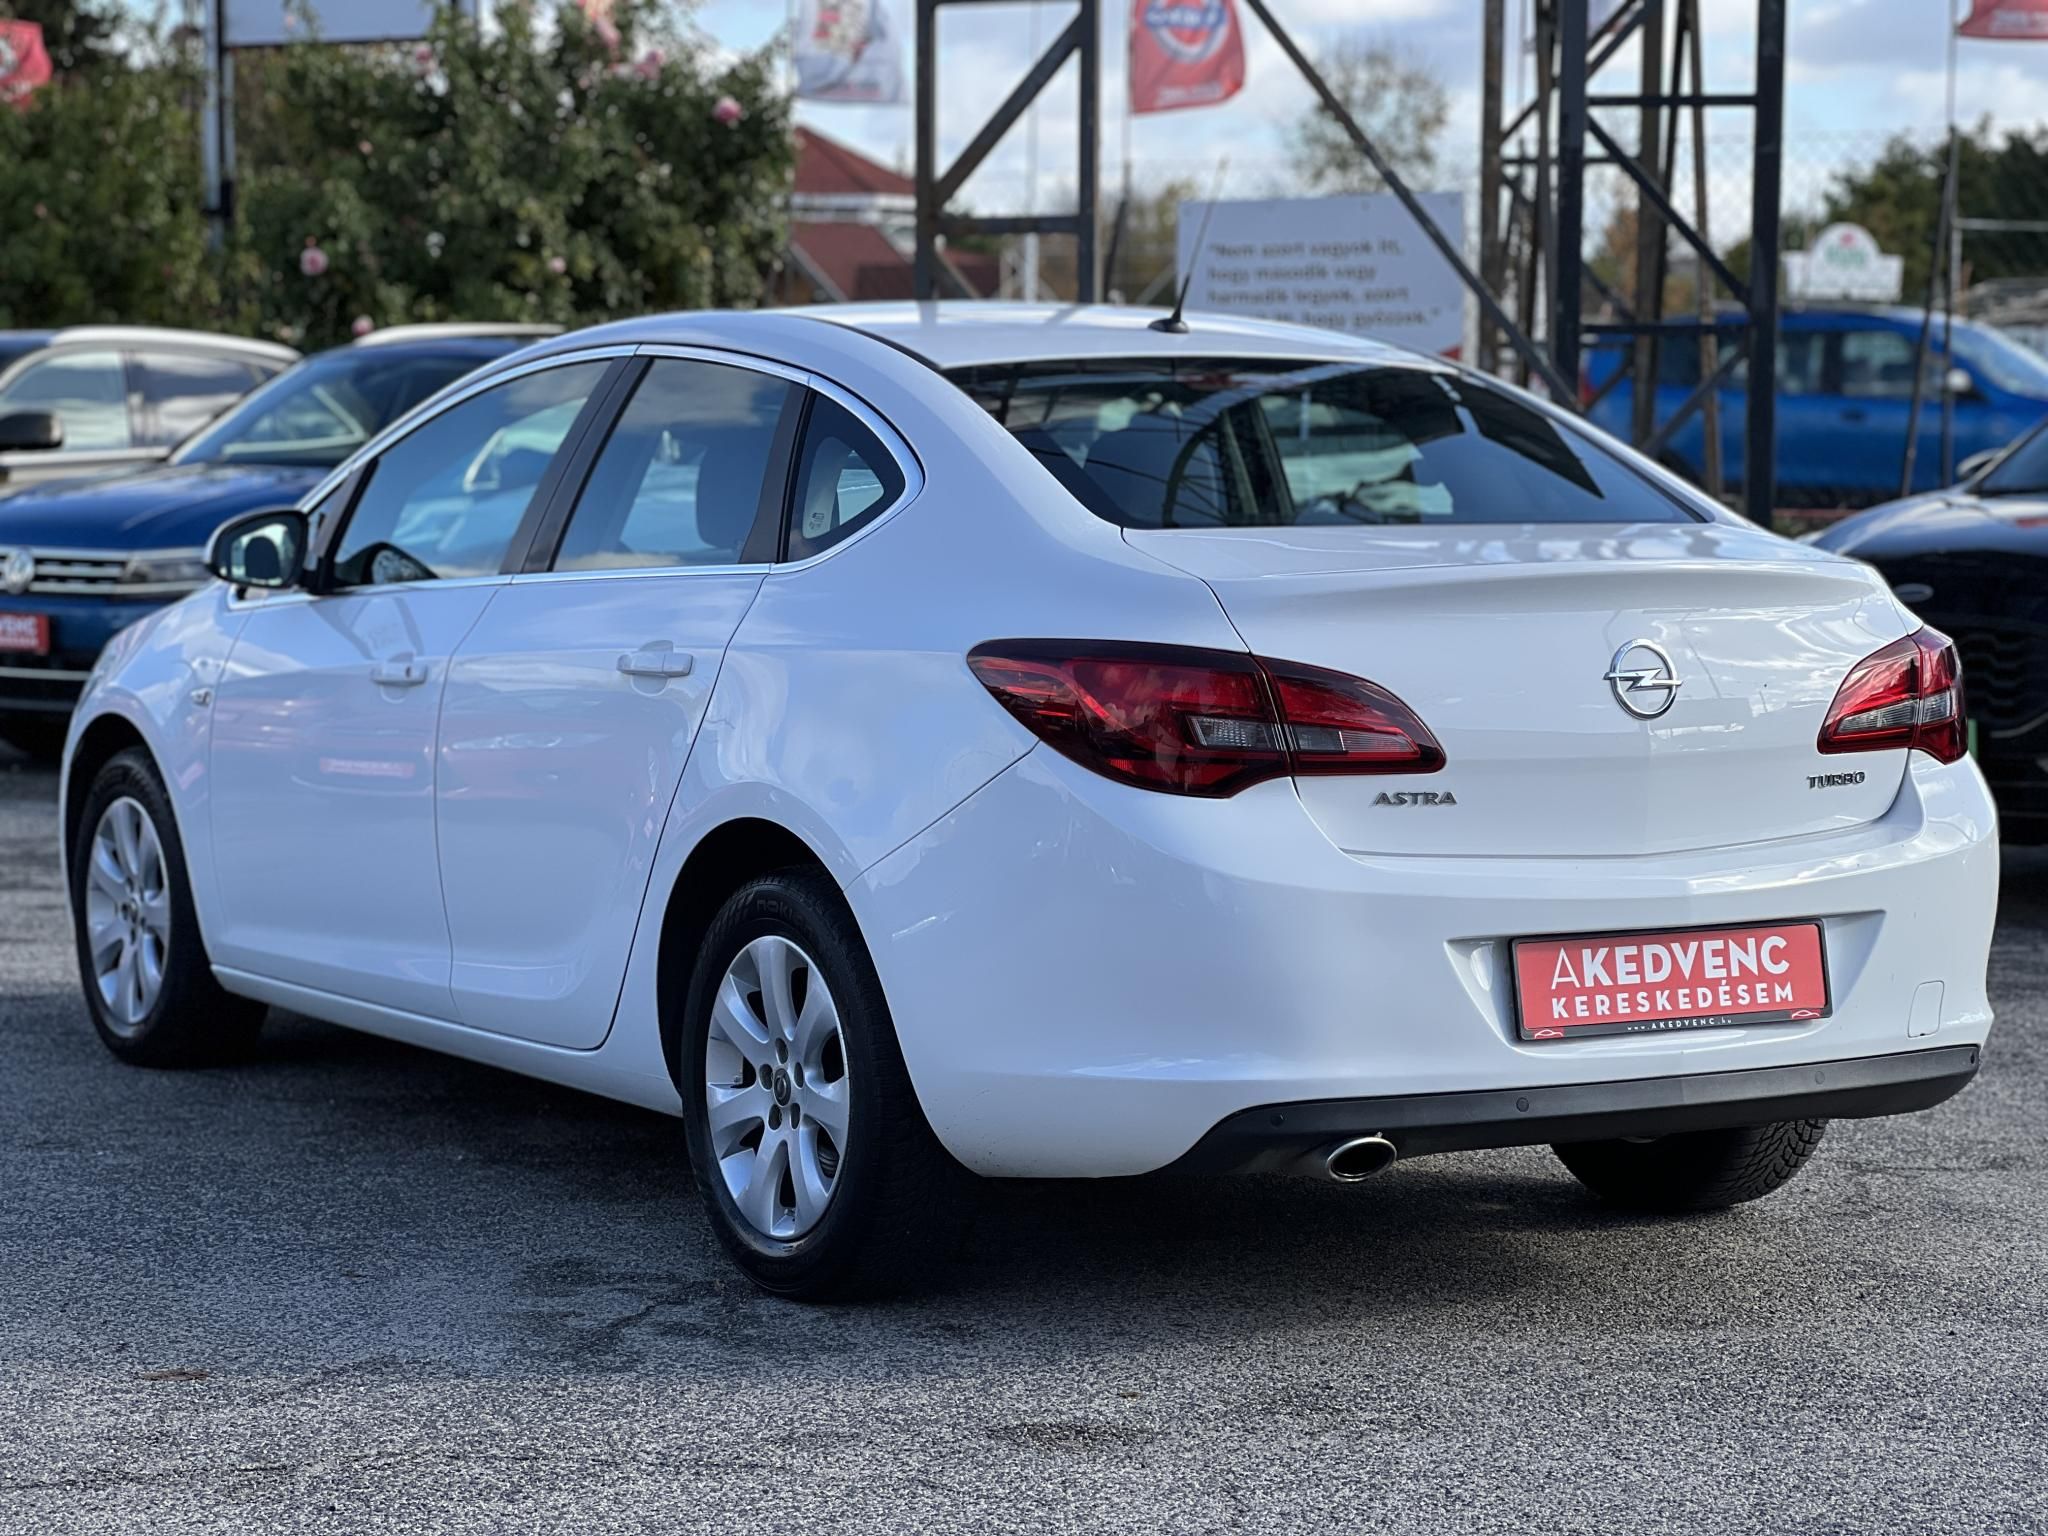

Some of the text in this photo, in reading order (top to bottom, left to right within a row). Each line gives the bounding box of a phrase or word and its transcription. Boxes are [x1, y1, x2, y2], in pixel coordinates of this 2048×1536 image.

[1807, 771, 1865, 789] TURBO
[1374, 791, 1457, 805] ASTRA
[1551, 979, 1794, 1019] KERESKEDÉSEM
